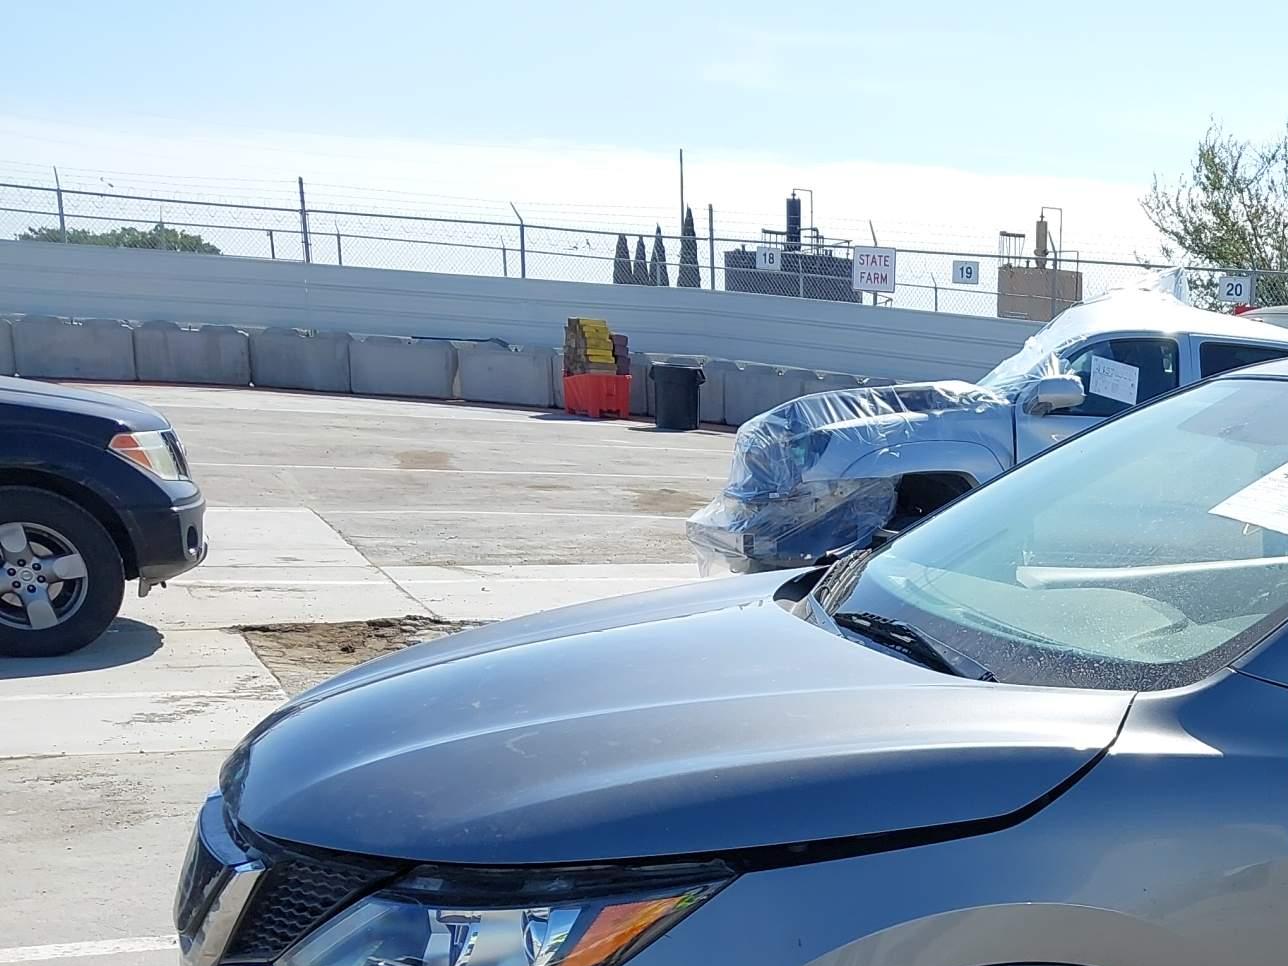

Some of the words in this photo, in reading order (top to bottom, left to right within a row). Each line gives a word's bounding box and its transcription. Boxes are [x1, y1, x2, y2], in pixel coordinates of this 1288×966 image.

[762, 252, 775, 265] 18
[859, 254, 890, 267] STATE
[860, 271, 888, 285] FARM
[958, 265, 973, 279] 19
[1226, 282, 1243, 297] 20
